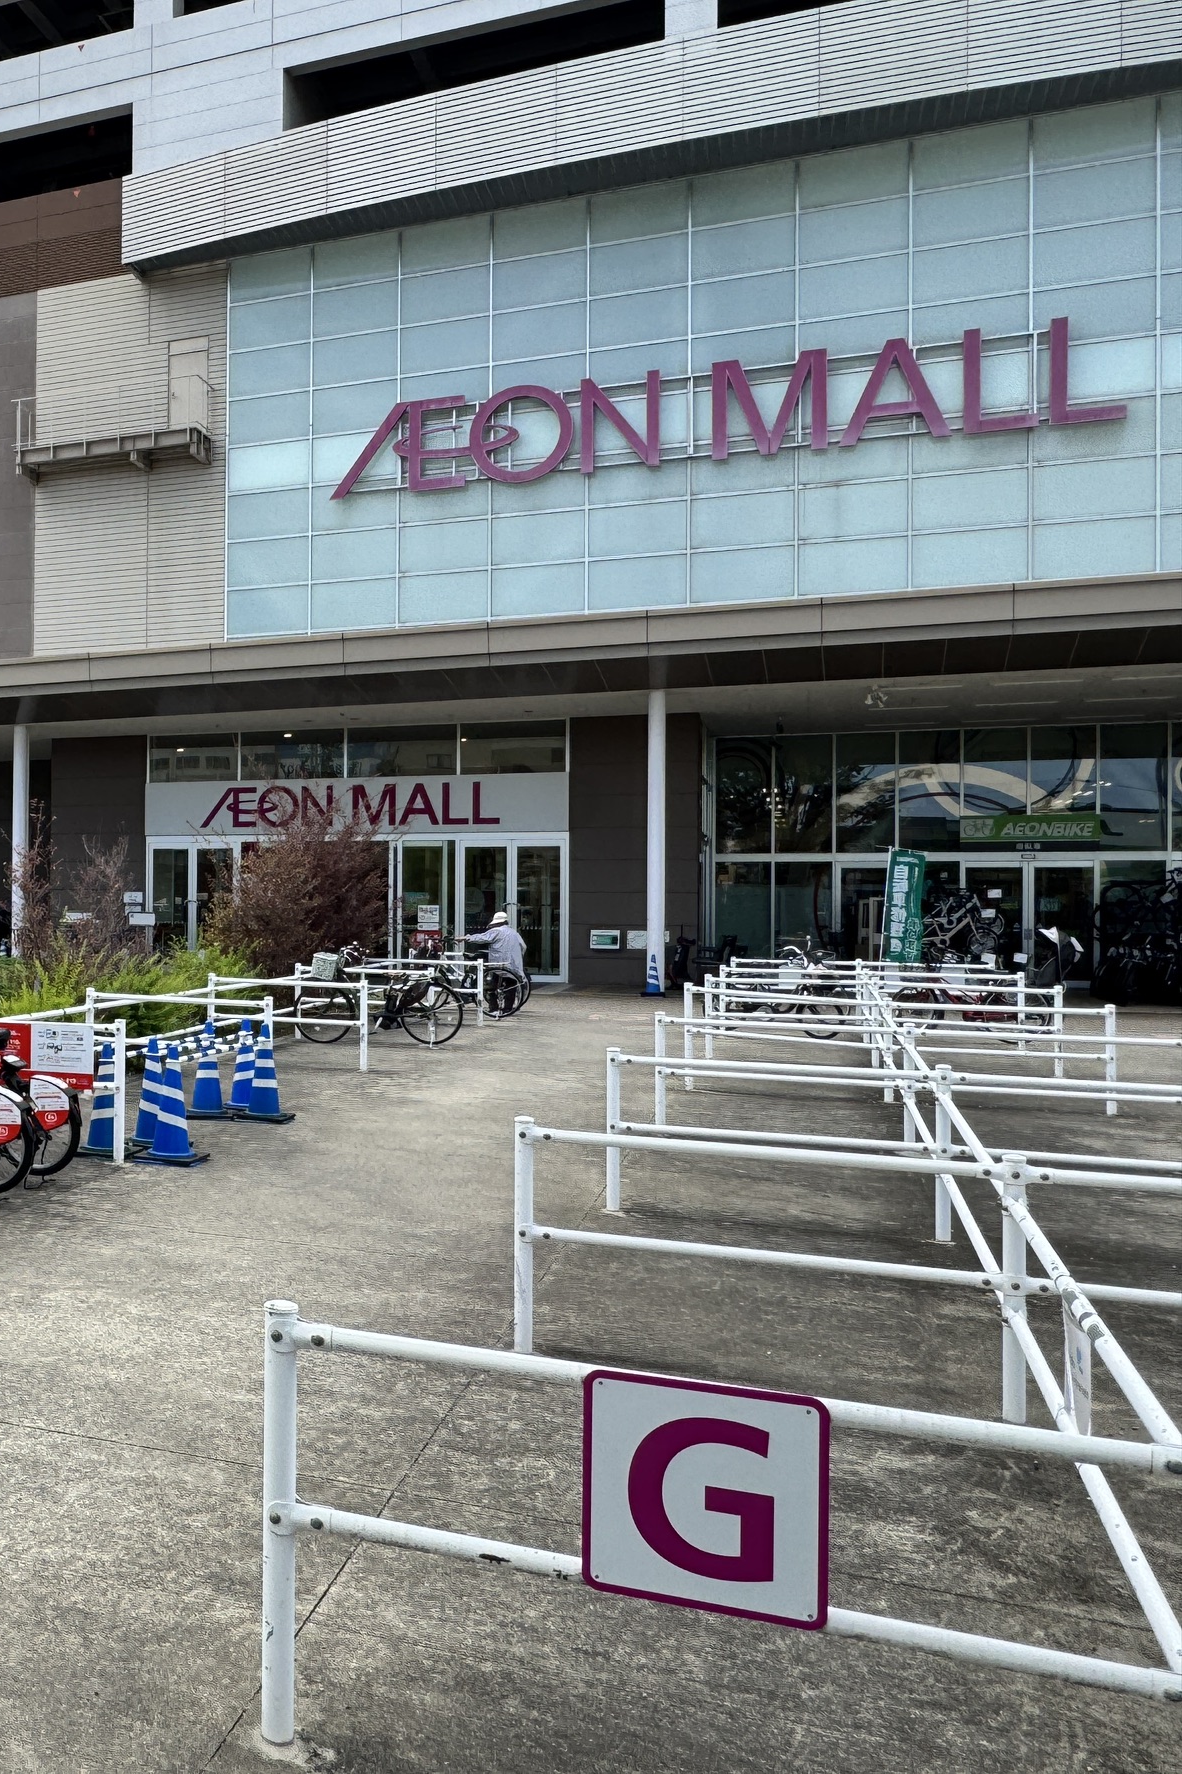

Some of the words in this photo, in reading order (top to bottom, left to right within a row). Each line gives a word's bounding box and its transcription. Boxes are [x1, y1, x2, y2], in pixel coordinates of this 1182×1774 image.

[711, 316, 1127, 463] MALL
[351, 781, 500, 826] MALL
[1000, 821, 1095, 837] AEONBIKE
[627, 1416, 775, 1583] G
